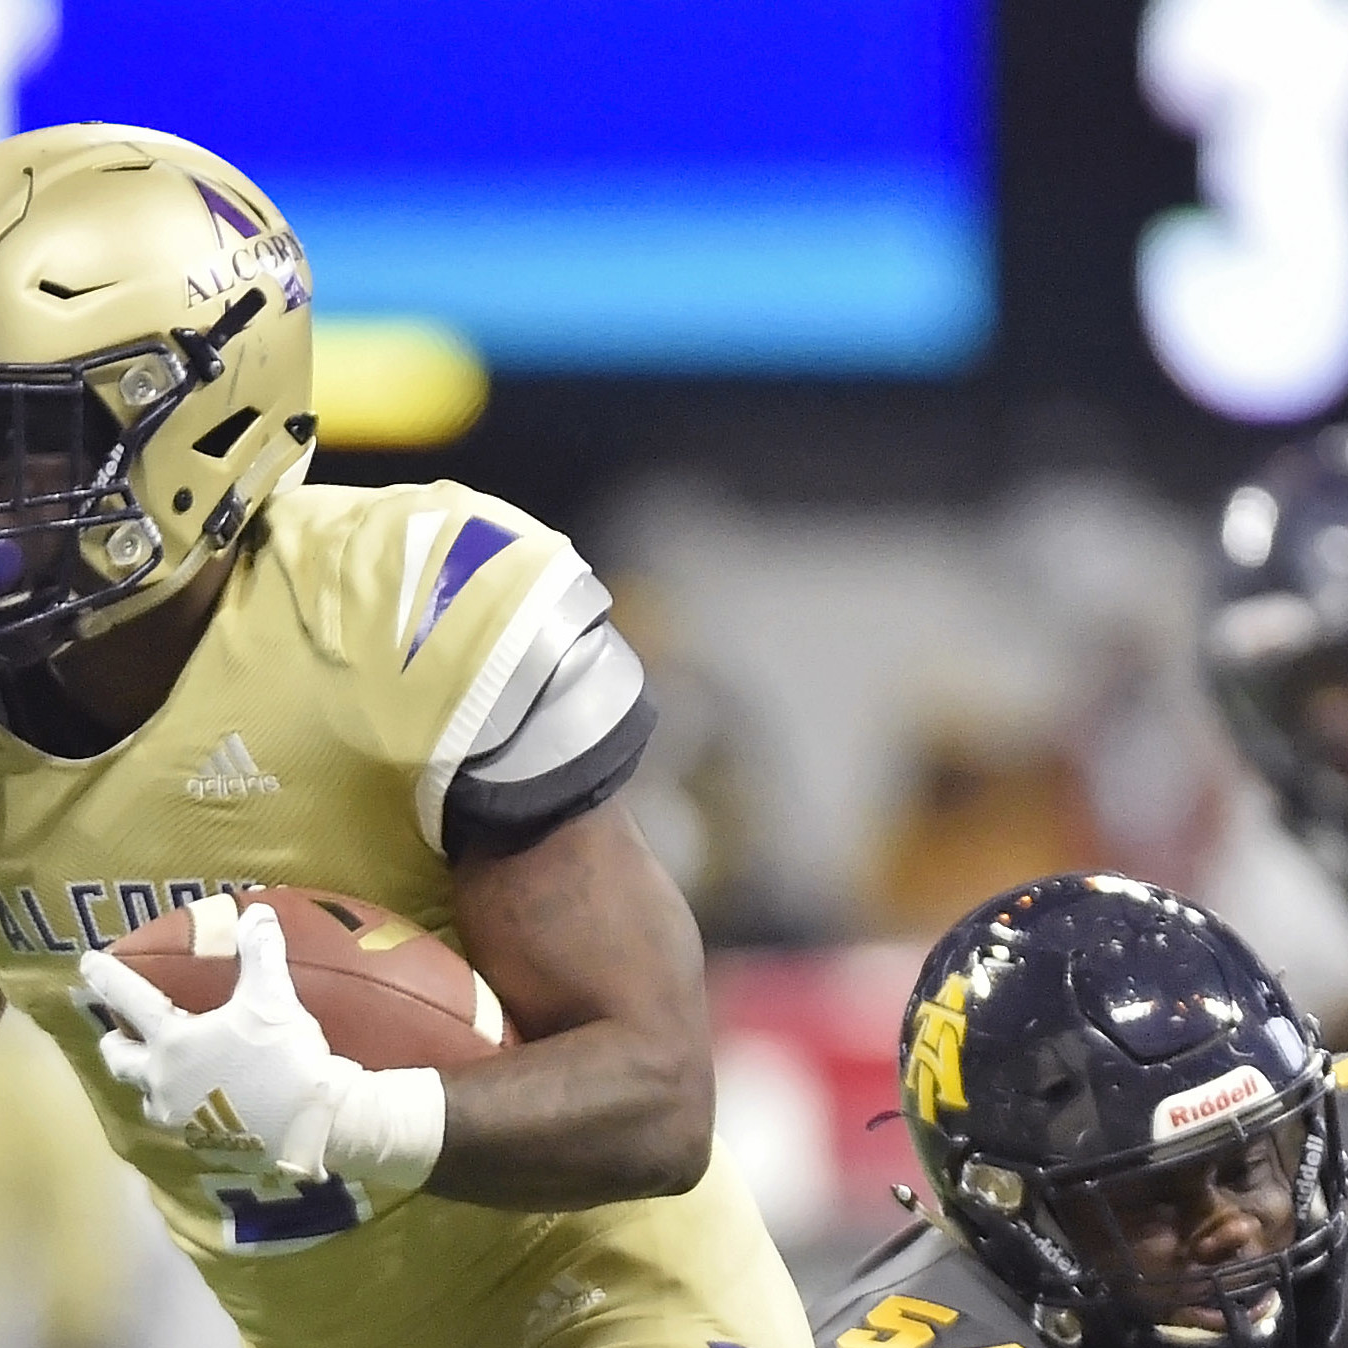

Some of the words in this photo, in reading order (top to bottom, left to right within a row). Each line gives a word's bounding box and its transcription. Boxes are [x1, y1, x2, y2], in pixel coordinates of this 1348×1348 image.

[186, 231, 304, 309] ALCORN
[187, 774, 281, 800] adidas
[1169, 1073, 1259, 1127] Riddell
